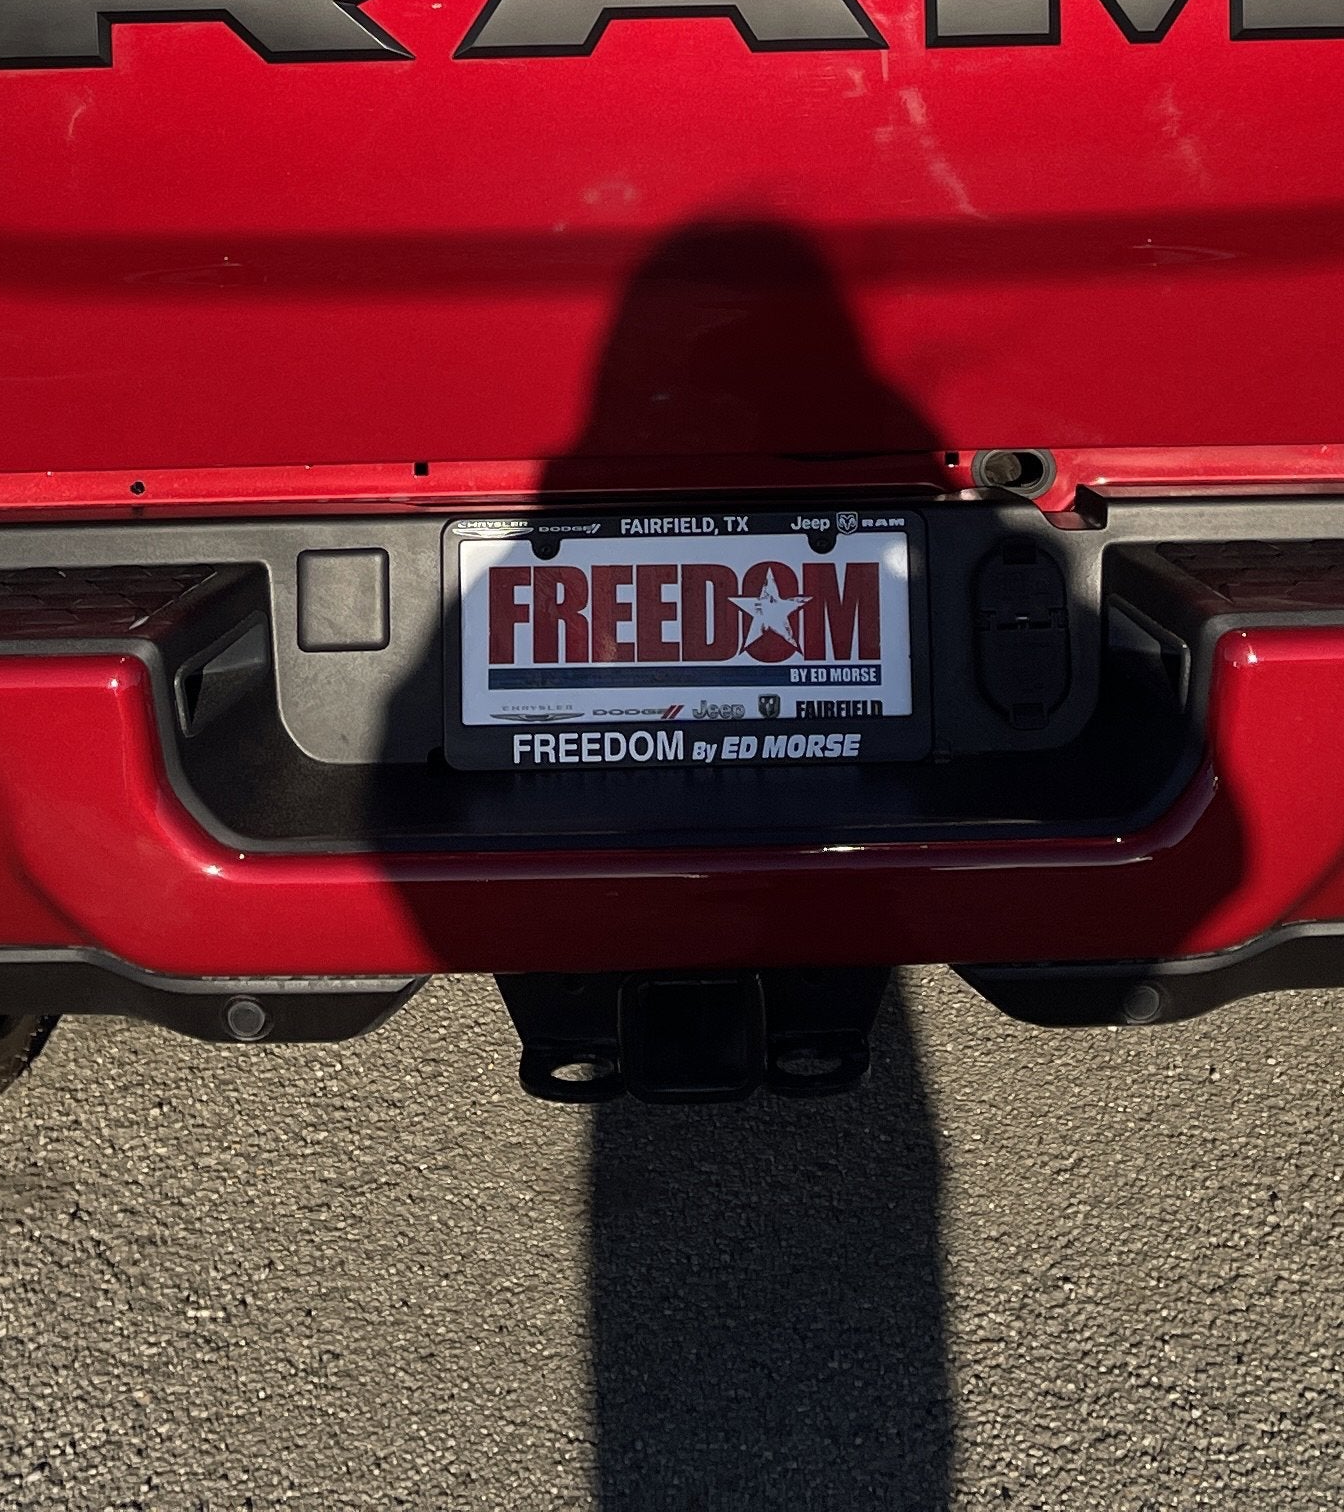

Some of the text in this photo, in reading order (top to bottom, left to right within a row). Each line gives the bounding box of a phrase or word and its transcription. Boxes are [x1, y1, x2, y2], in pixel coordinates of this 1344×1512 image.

[620, 518, 720, 536] FAIRFIELD,
[723, 516, 750, 533] TX
[790, 516, 831, 532] Jeep
[861, 518, 905, 527] RAM
[488, 562, 882, 665] FREEDOM
[789, 667, 877, 683] BY ED MORSE
[501, 699, 884, 720] CHRYSLER DODGE Jeep FAIRFIELD
[512, 730, 861, 765] FREEDOM By ED MORSE
